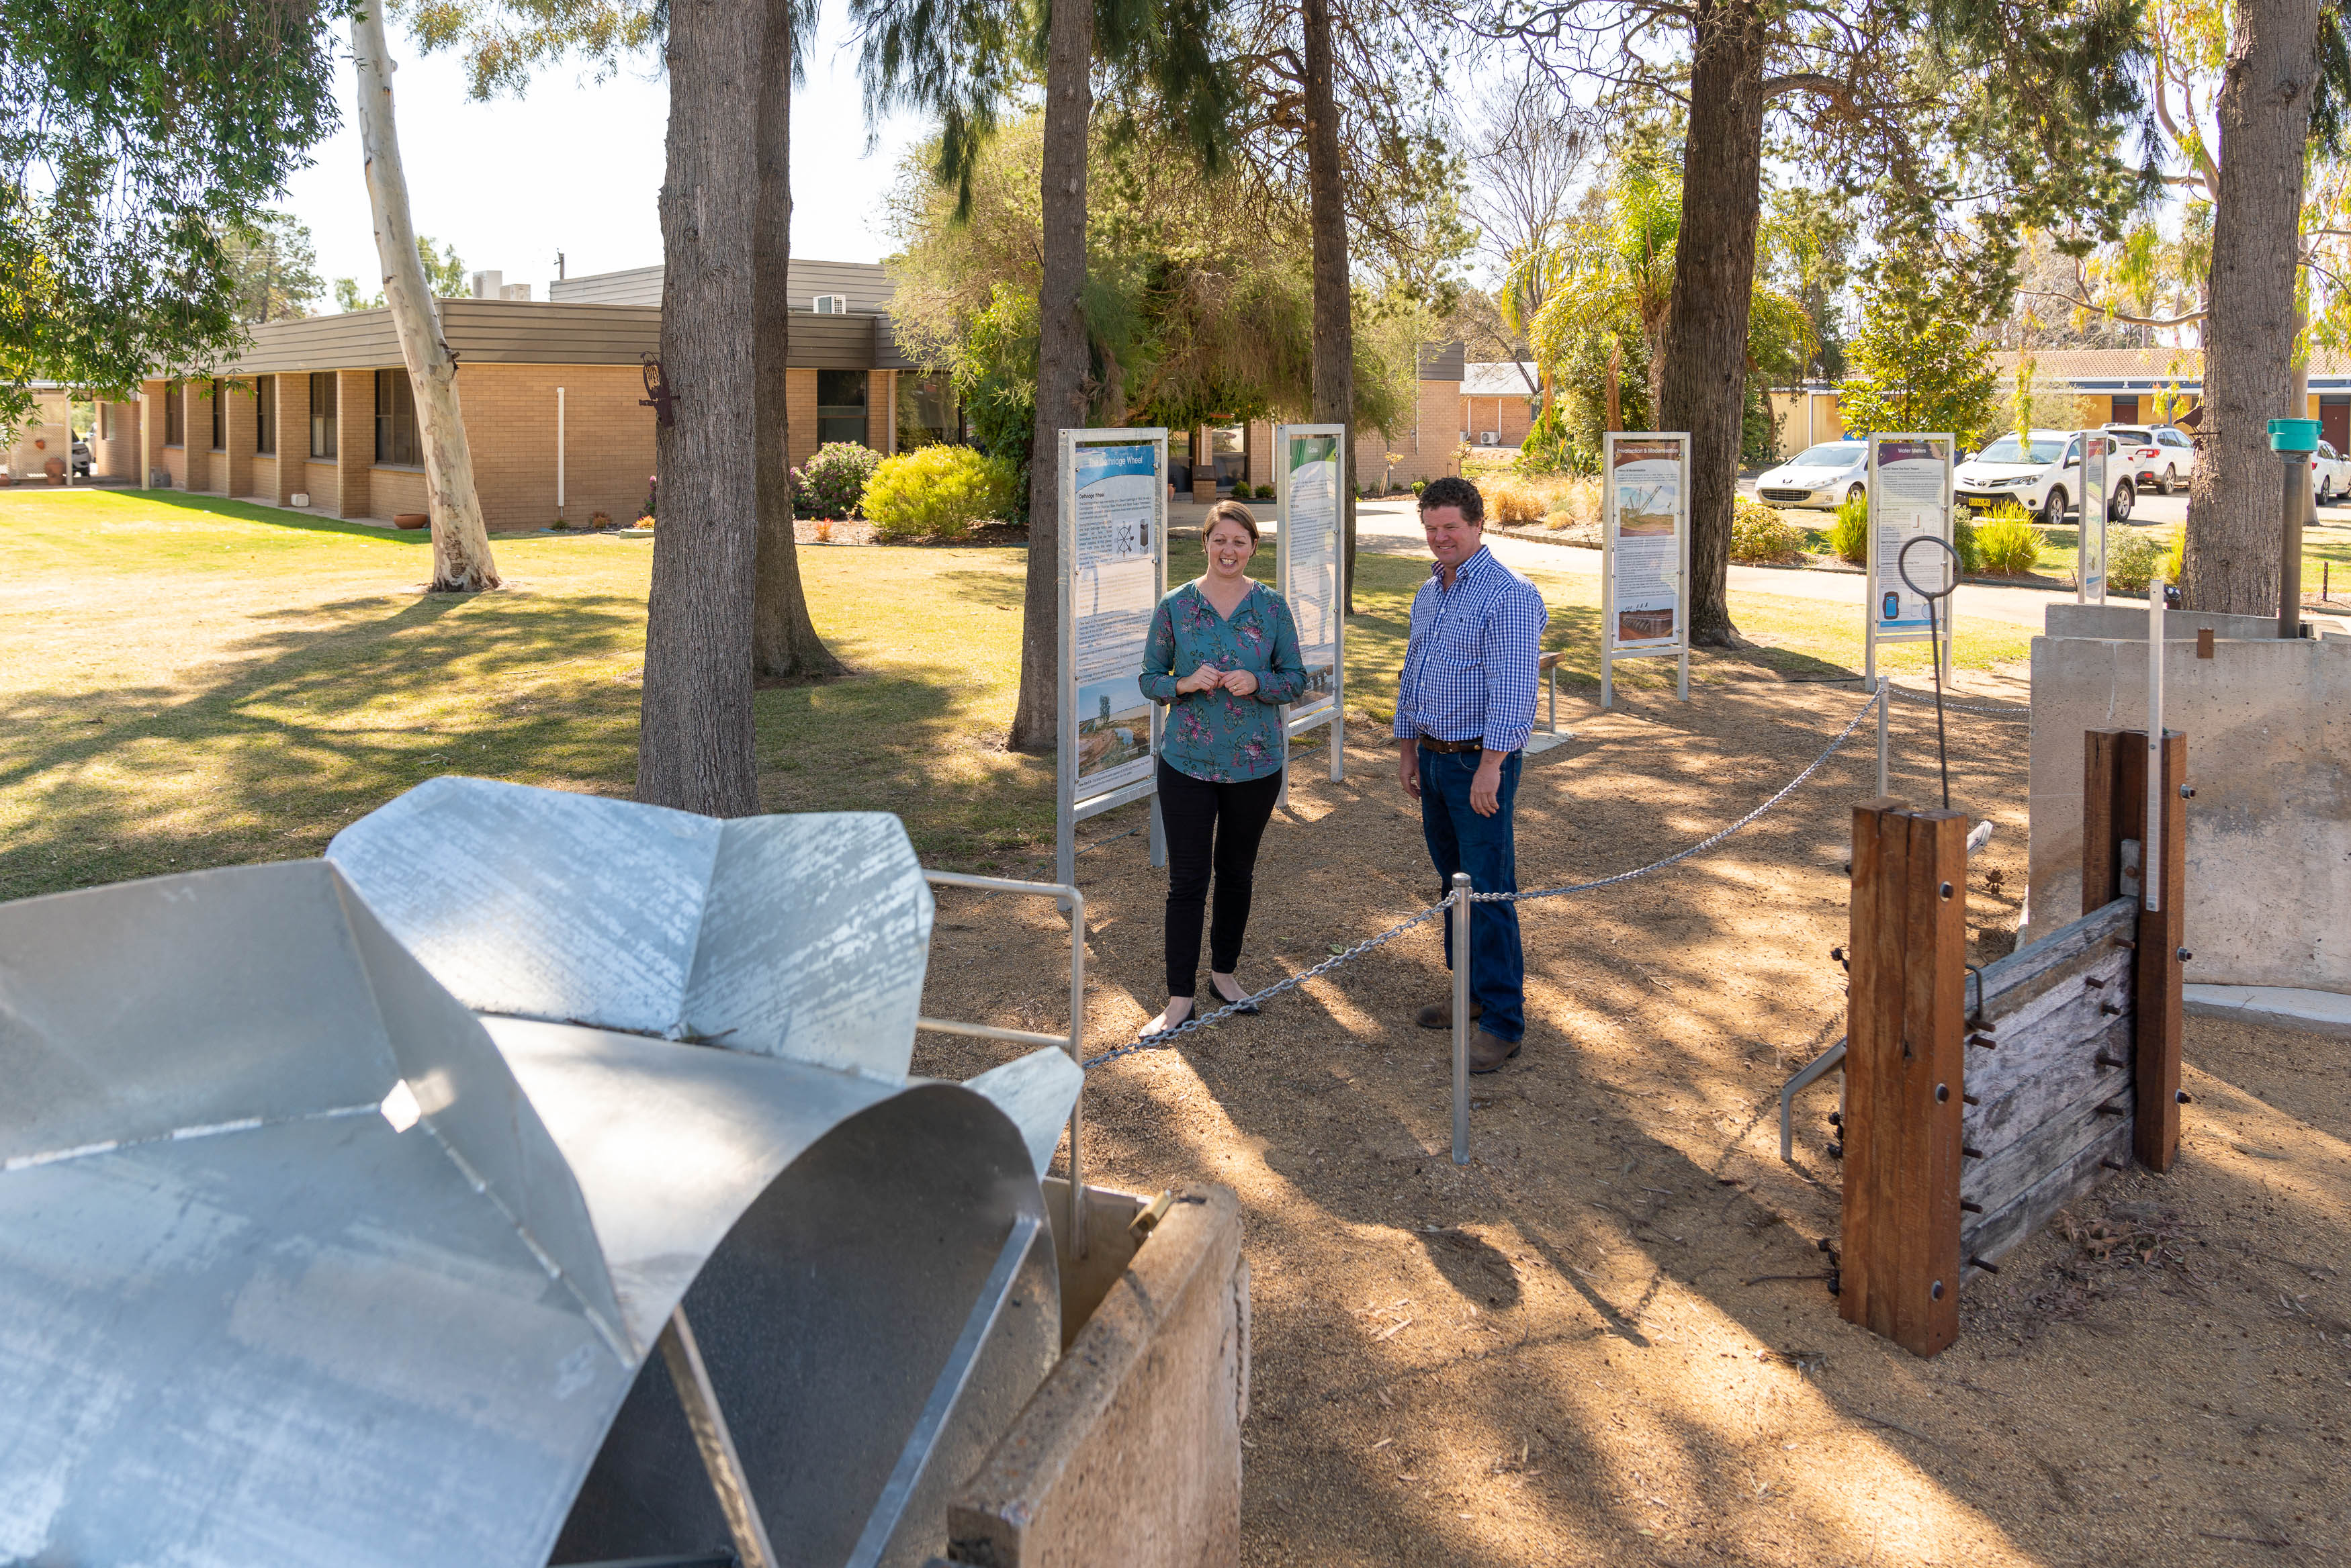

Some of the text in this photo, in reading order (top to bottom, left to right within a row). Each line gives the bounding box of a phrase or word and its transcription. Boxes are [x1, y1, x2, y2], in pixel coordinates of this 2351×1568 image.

[1308, 446, 1319, 454] Gates
[1100, 457, 1126, 467] Dethridge
[1127, 456, 1143, 465] Wheel
